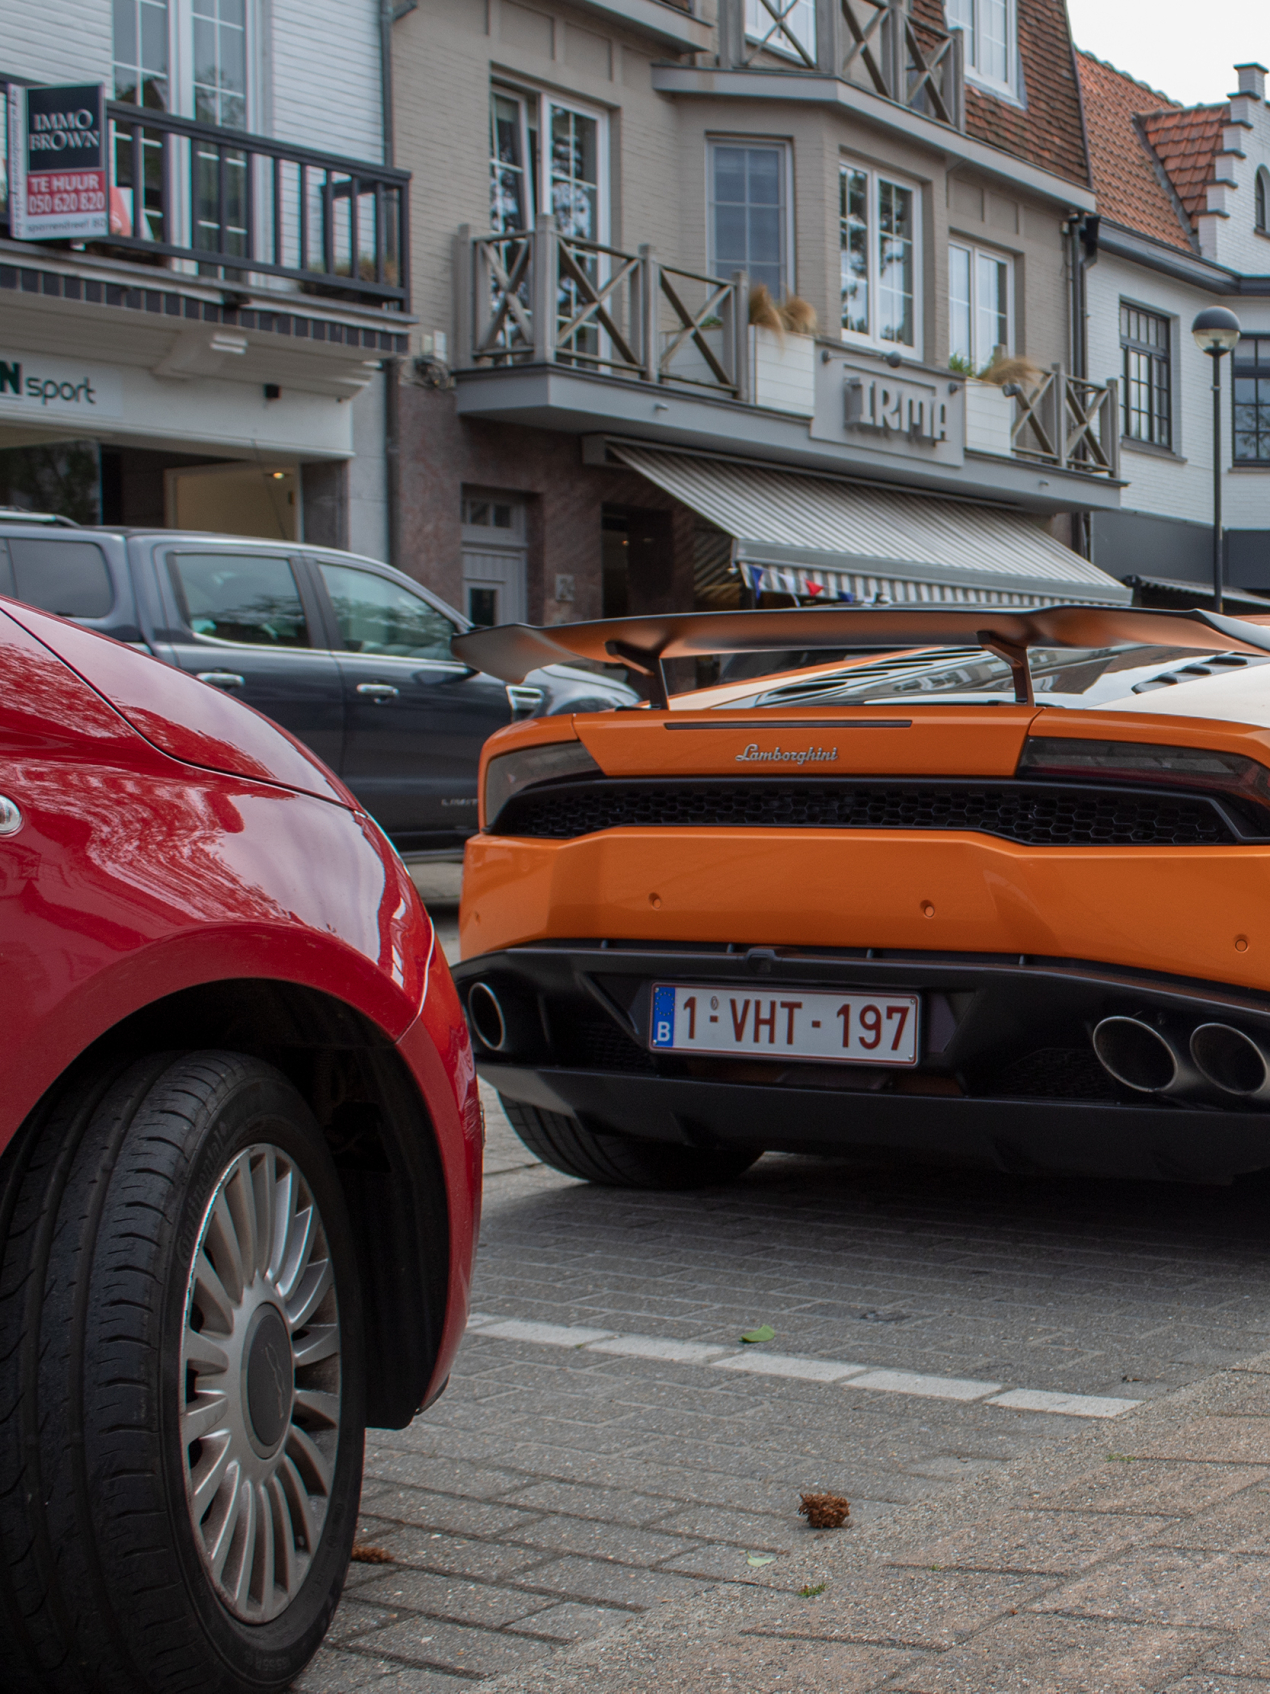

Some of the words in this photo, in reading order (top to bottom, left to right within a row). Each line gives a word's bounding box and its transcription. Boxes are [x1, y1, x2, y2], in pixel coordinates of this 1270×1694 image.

[33, 108, 94, 131] IMMO
[28, 130, 101, 151] BROWN
[30, 176, 50, 193] TE
[52, 174, 100, 192] HUUR
[28, 193, 53, 214] 050
[54, 192, 79, 213] 620
[80, 190, 106, 211] 820
[26, 376, 96, 406] sport
[735, 743, 838, 766] Lamborghini
[441, 798, 478, 806] LIMIT
[656, 1021, 670, 1042] B
